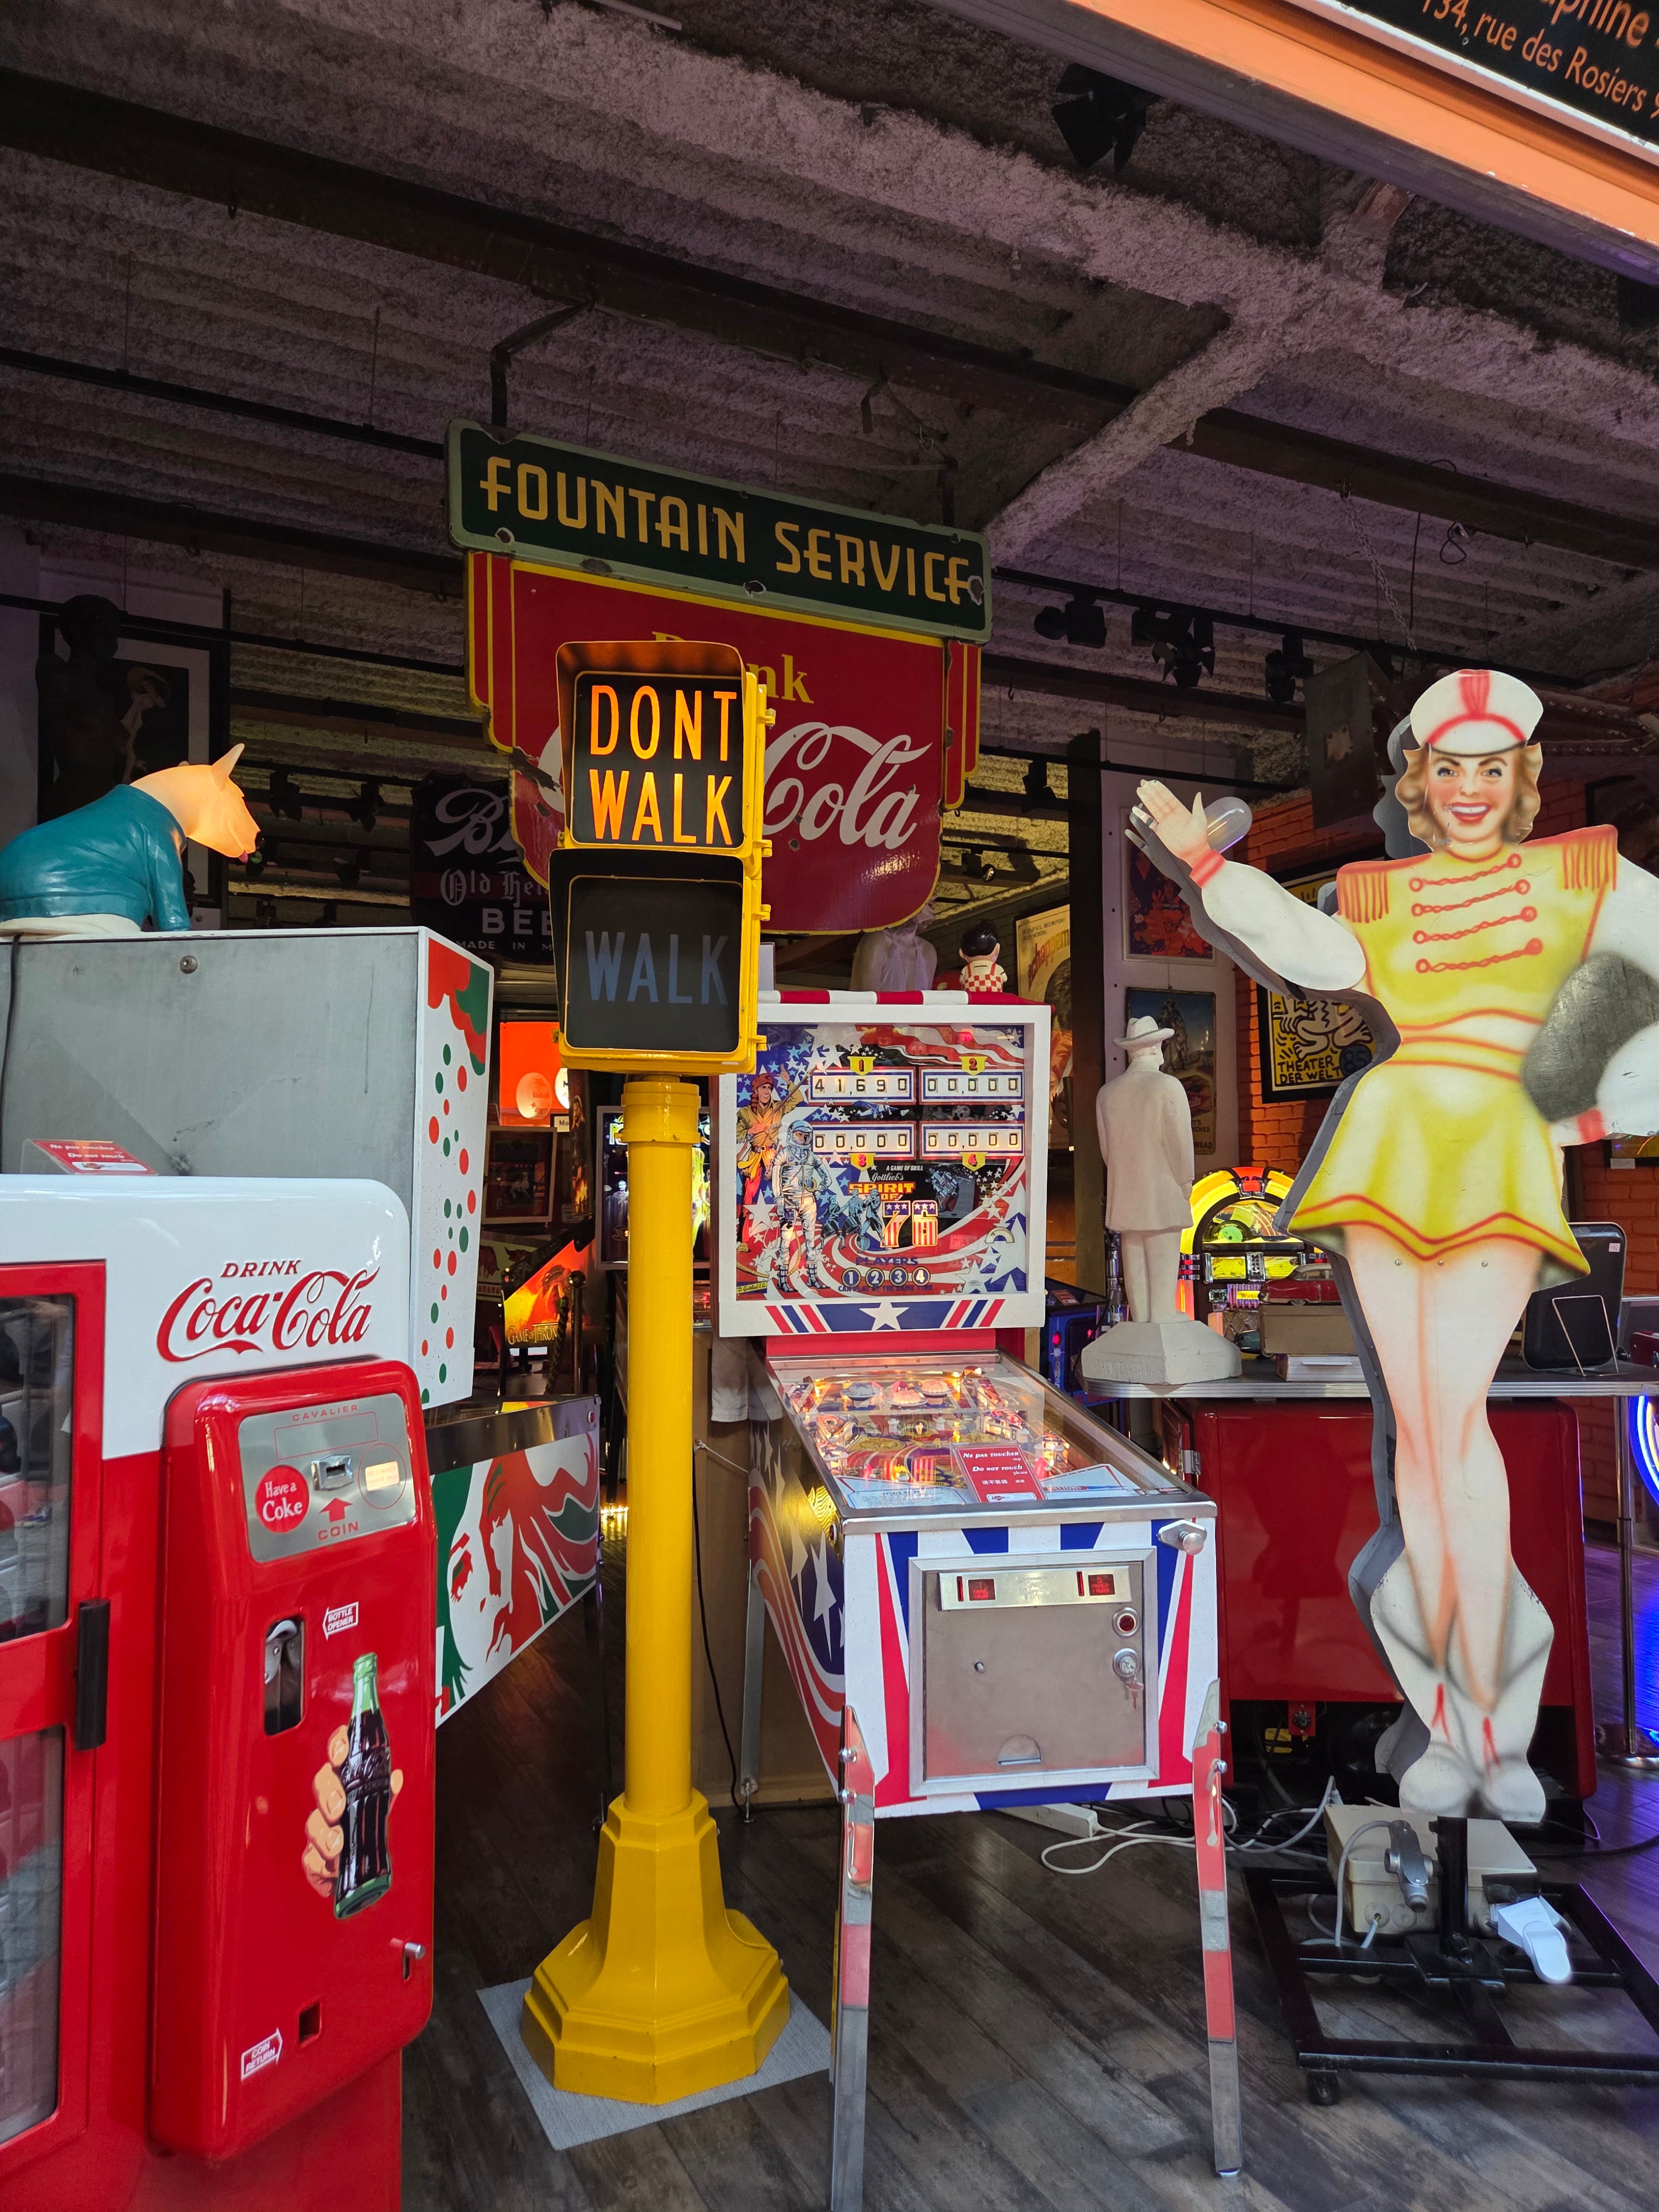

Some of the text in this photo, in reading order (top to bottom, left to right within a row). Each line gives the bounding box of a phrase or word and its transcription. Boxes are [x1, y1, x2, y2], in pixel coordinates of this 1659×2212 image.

[1540, 0, 1650, 48] phine
[1473, 13, 1517, 51] rue
[1522, 28, 1563, 72] des
[1564, 45, 1647, 112] Rosiers
[480, 456, 971, 605] FOUNTAIN SERVICE
[590, 685, 737, 761] DONT
[589, 769, 733, 846] WALK
[441, 868, 491, 906] Old
[513, 942, 525, 950] IN
[585, 931, 729, 1005] WALK
[1277, 1055, 1334, 1073] THEATER
[1280, 1066, 1341, 1084] DER WELT
[872, 1172, 904, 1183] Gottlieb's
[849, 1182, 915, 1193] SPIRIT
[219, 1259, 301, 1278] DRINK
[855, 1257, 919, 1266] PLAYERS
[848, 1269, 925, 1285] 1 2 3 4
[156, 1266, 380, 1363] Coca-Cola
[532, 1322, 559, 1343] THRON
[292, 1404, 358, 1422] CAVALIER
[264, 1481, 297, 1499] Have a
[262, 1497, 304, 1522] Coke
[317, 1521, 359, 1541] COIN
[327, 1615, 353, 1631] OPENER
[328, 1606, 353, 1623] BOTTLE
[252, 2041, 270, 2059] COIN
[246, 2047, 275, 2073] RETURN
